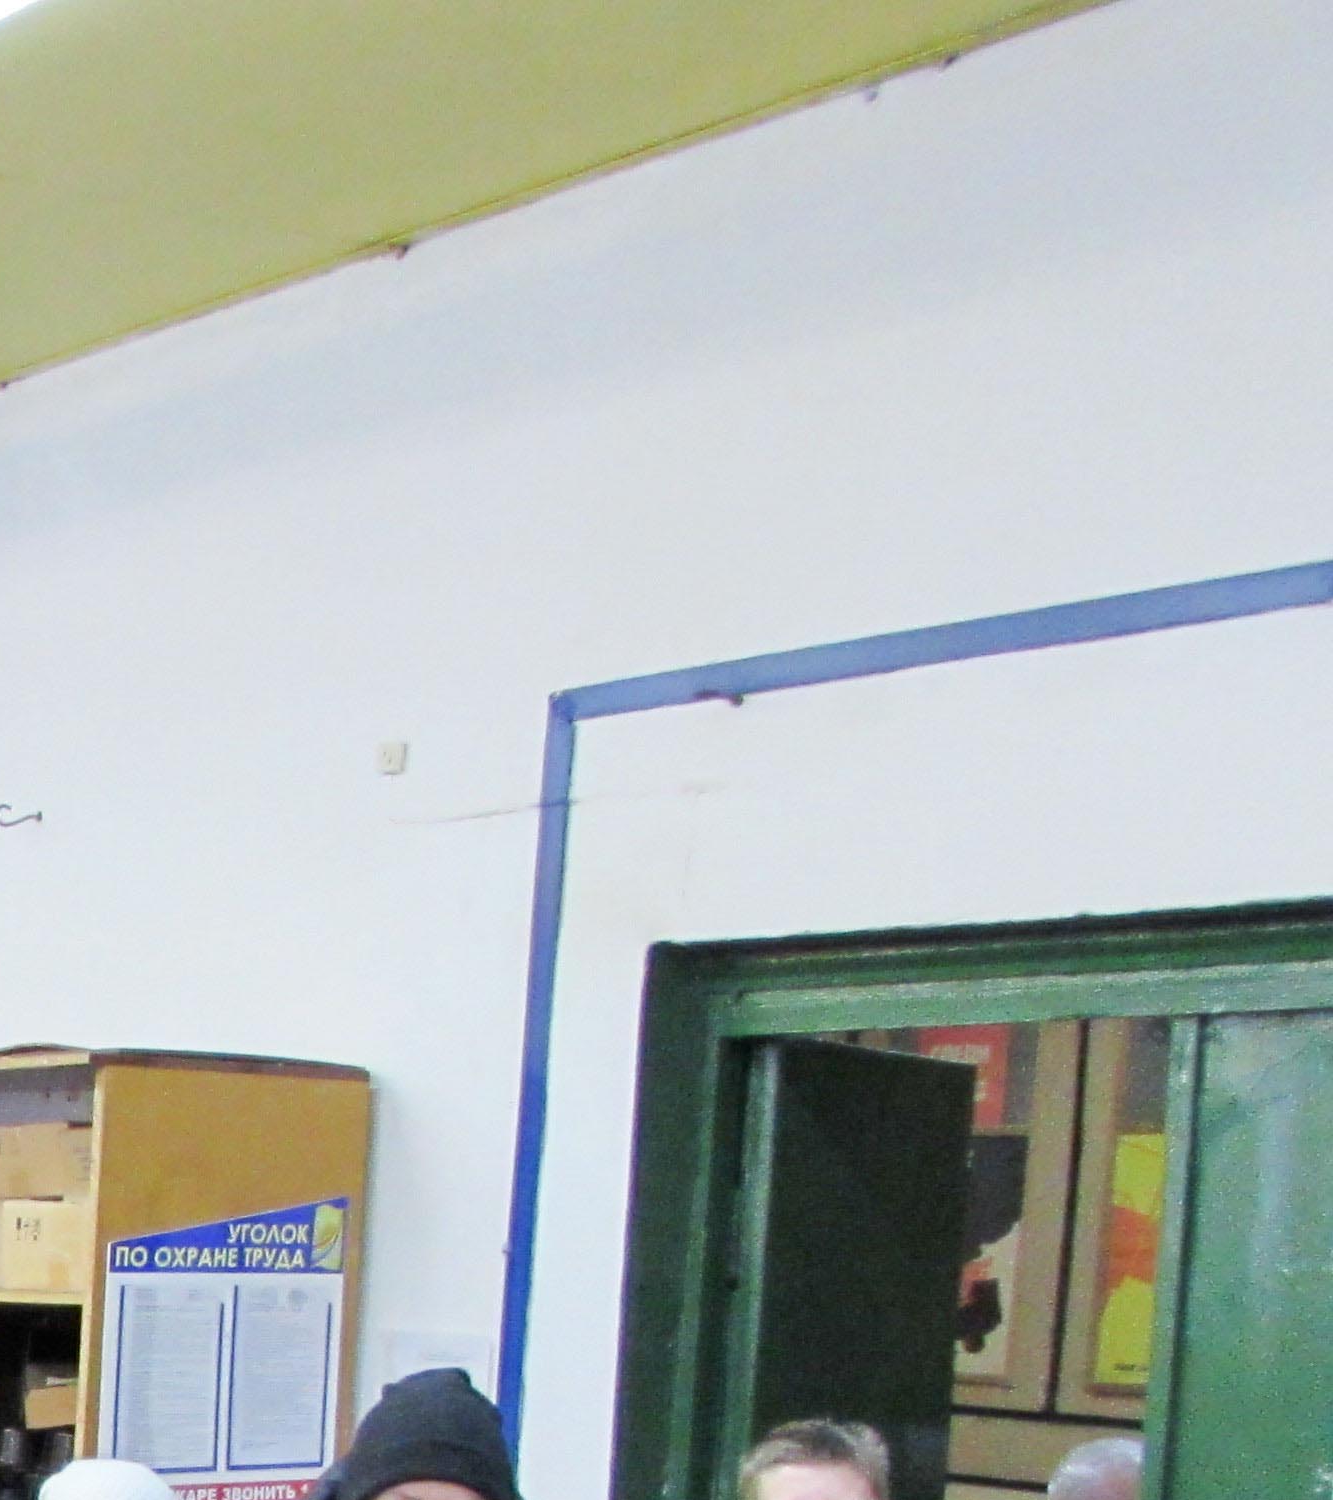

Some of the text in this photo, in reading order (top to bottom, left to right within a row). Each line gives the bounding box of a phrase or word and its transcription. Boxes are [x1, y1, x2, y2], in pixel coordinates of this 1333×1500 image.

[227, 1223, 310, 1244] УГОЛОК
[114, 1246, 305, 1269] ПО ОХРАНЕ ТРУДА
[221, 1485, 296, 1500] ЗВОНИТЬ
